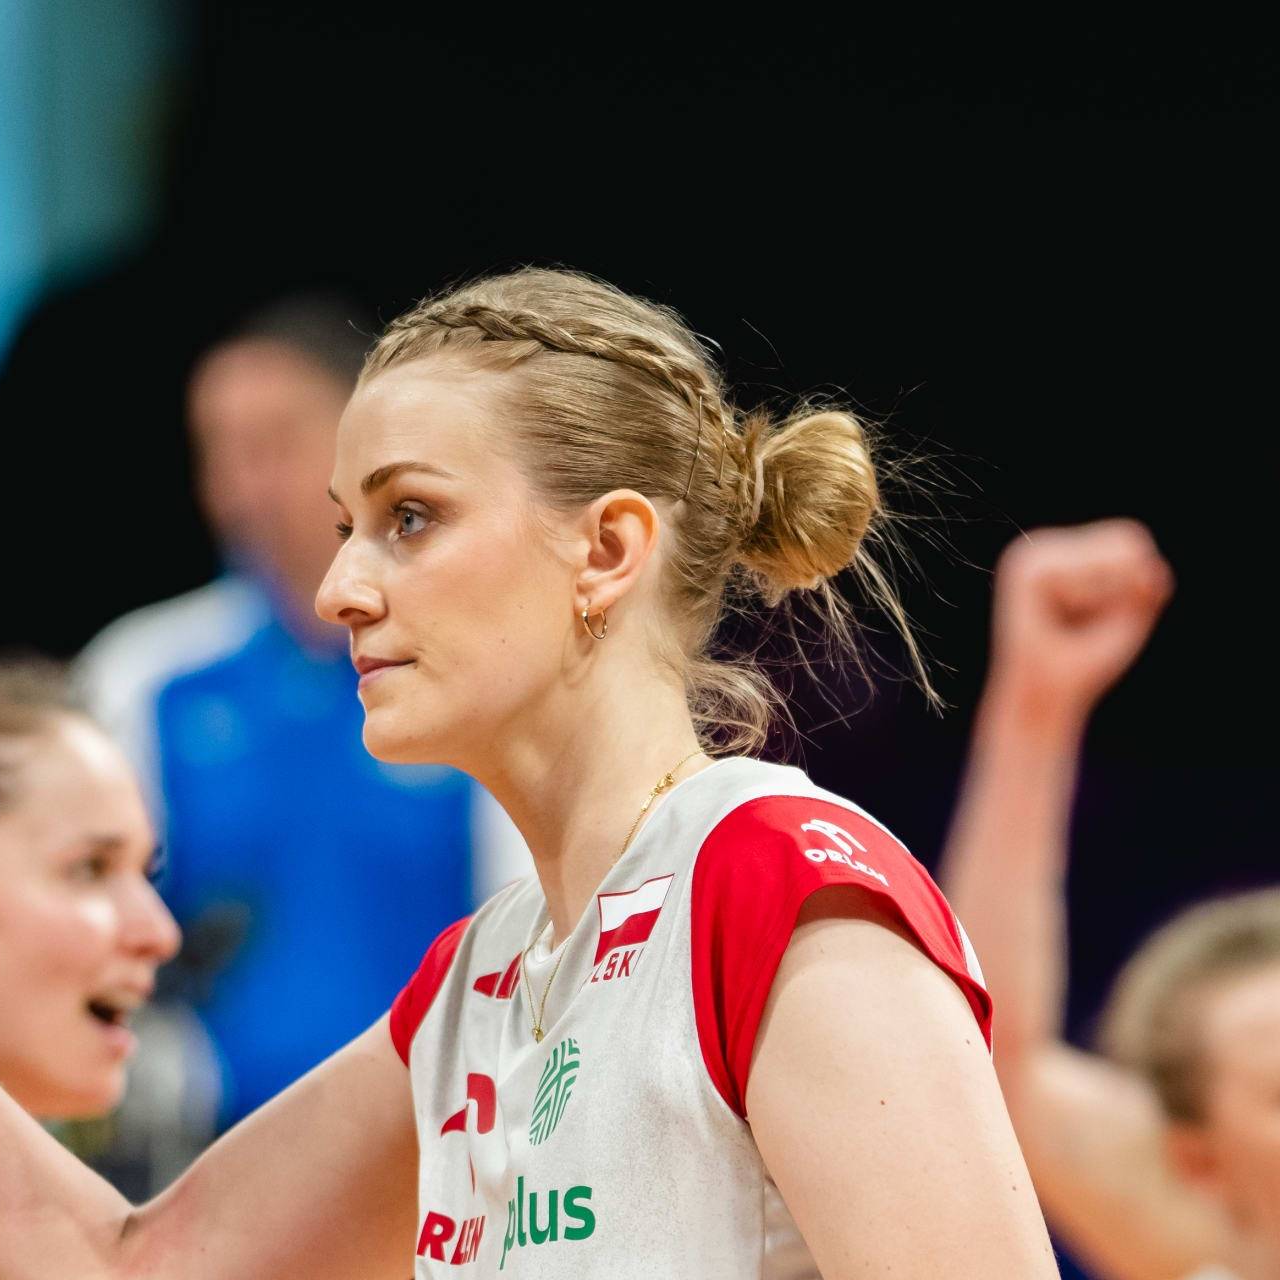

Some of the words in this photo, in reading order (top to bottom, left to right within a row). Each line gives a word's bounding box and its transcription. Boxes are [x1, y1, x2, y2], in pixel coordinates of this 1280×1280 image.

[804, 848, 889, 887] ORLEN
[416, 1210, 487, 1266] RLEN
[499, 1175, 596, 1271] plus
